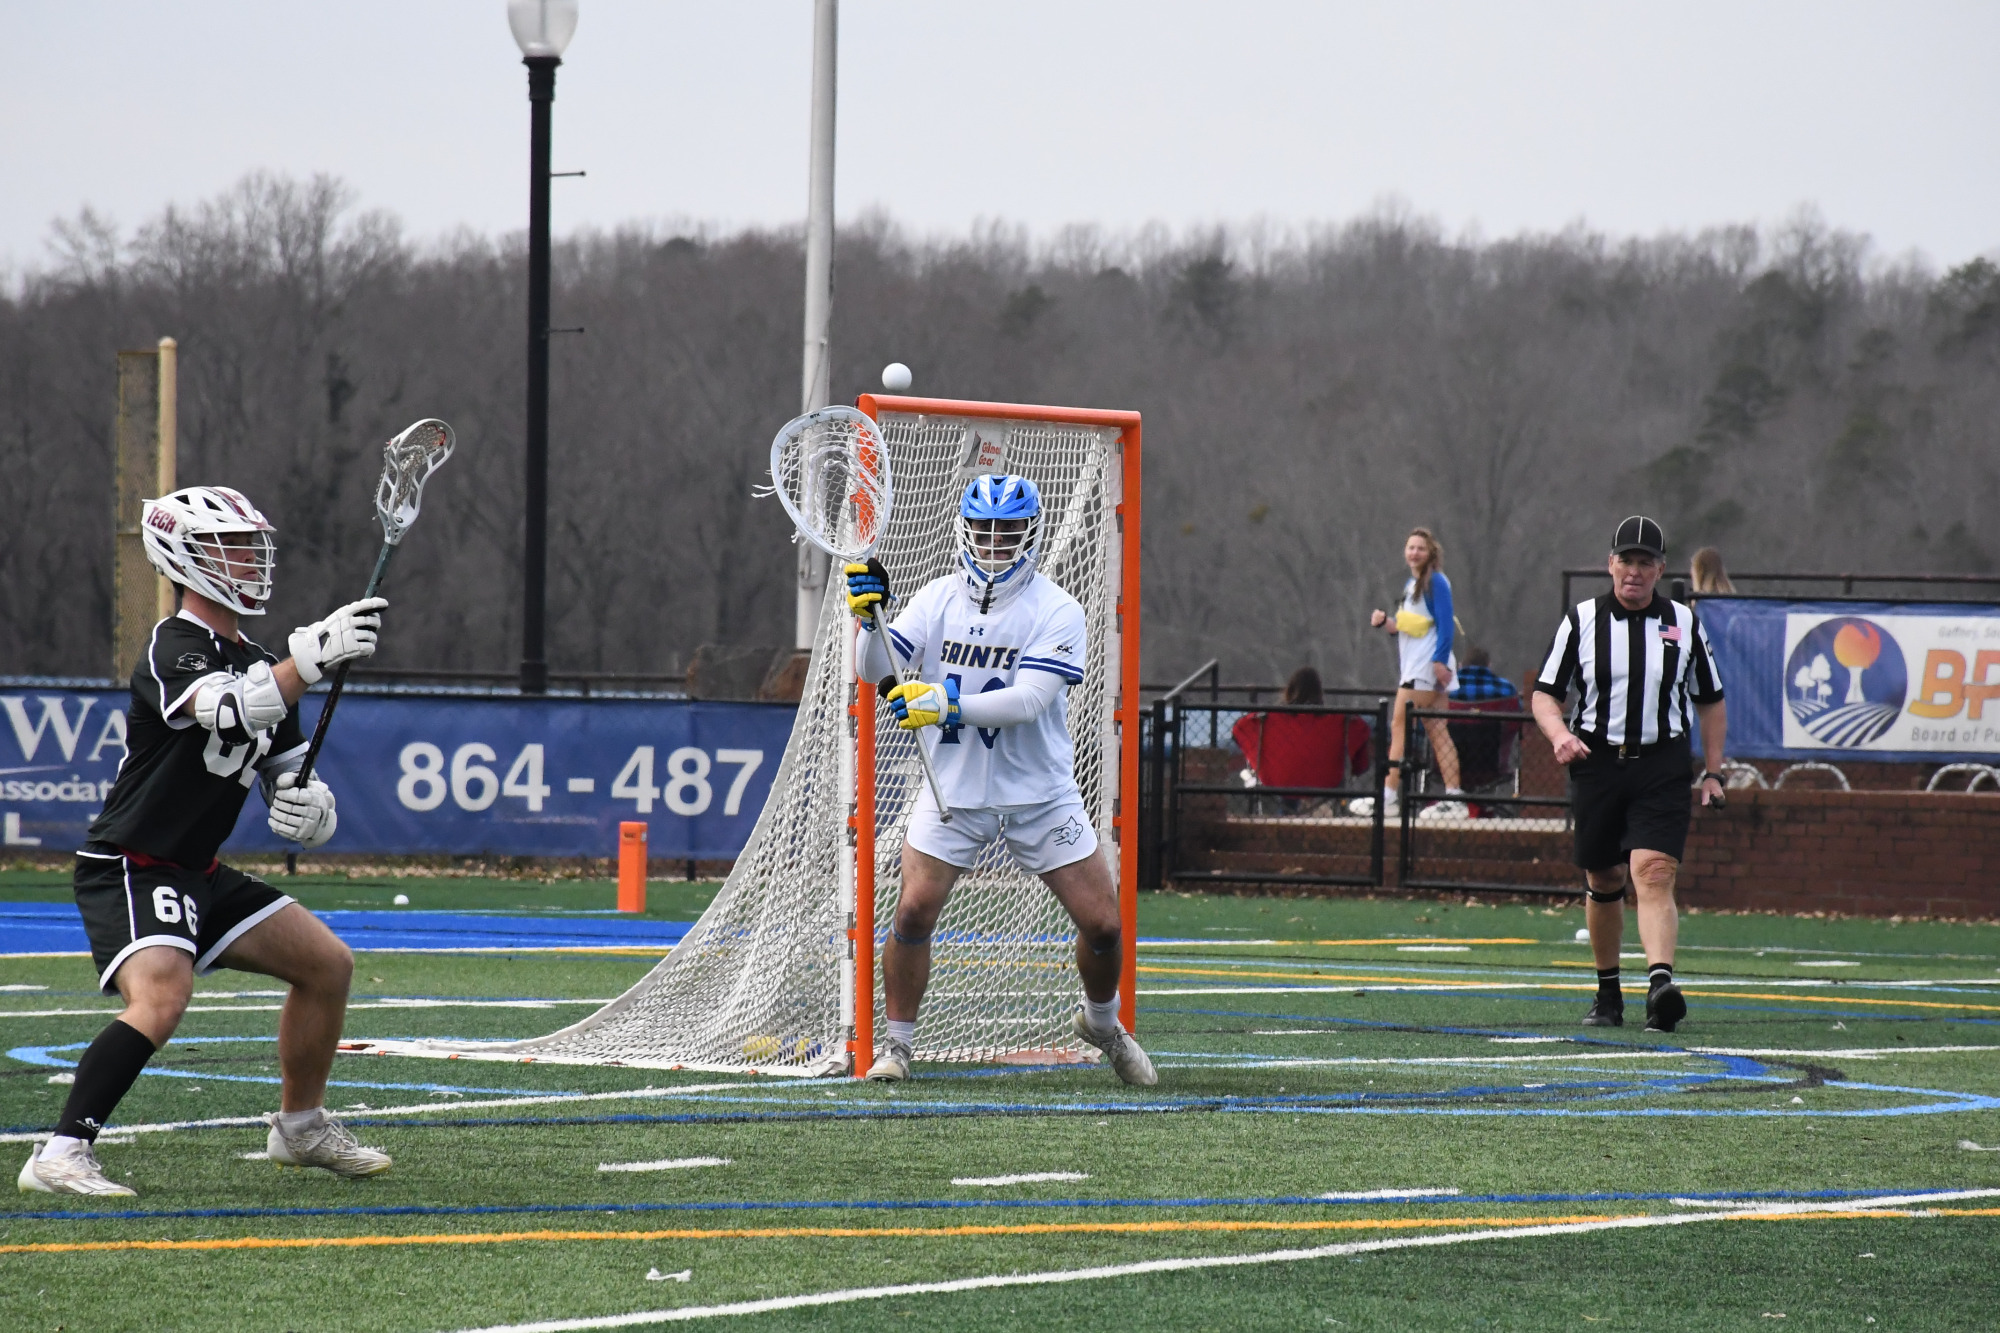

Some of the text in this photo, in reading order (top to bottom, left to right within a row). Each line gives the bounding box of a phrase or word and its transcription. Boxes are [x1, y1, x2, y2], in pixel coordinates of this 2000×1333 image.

[147, 506, 177, 534] TECH
[940, 640, 1019, 670] SAINTS
[1911, 726, 1957, 742] Board
[1962, 727, 1979, 742] of
[0, 774, 116, 801] ssociat
[152, 885, 198, 936] 66
